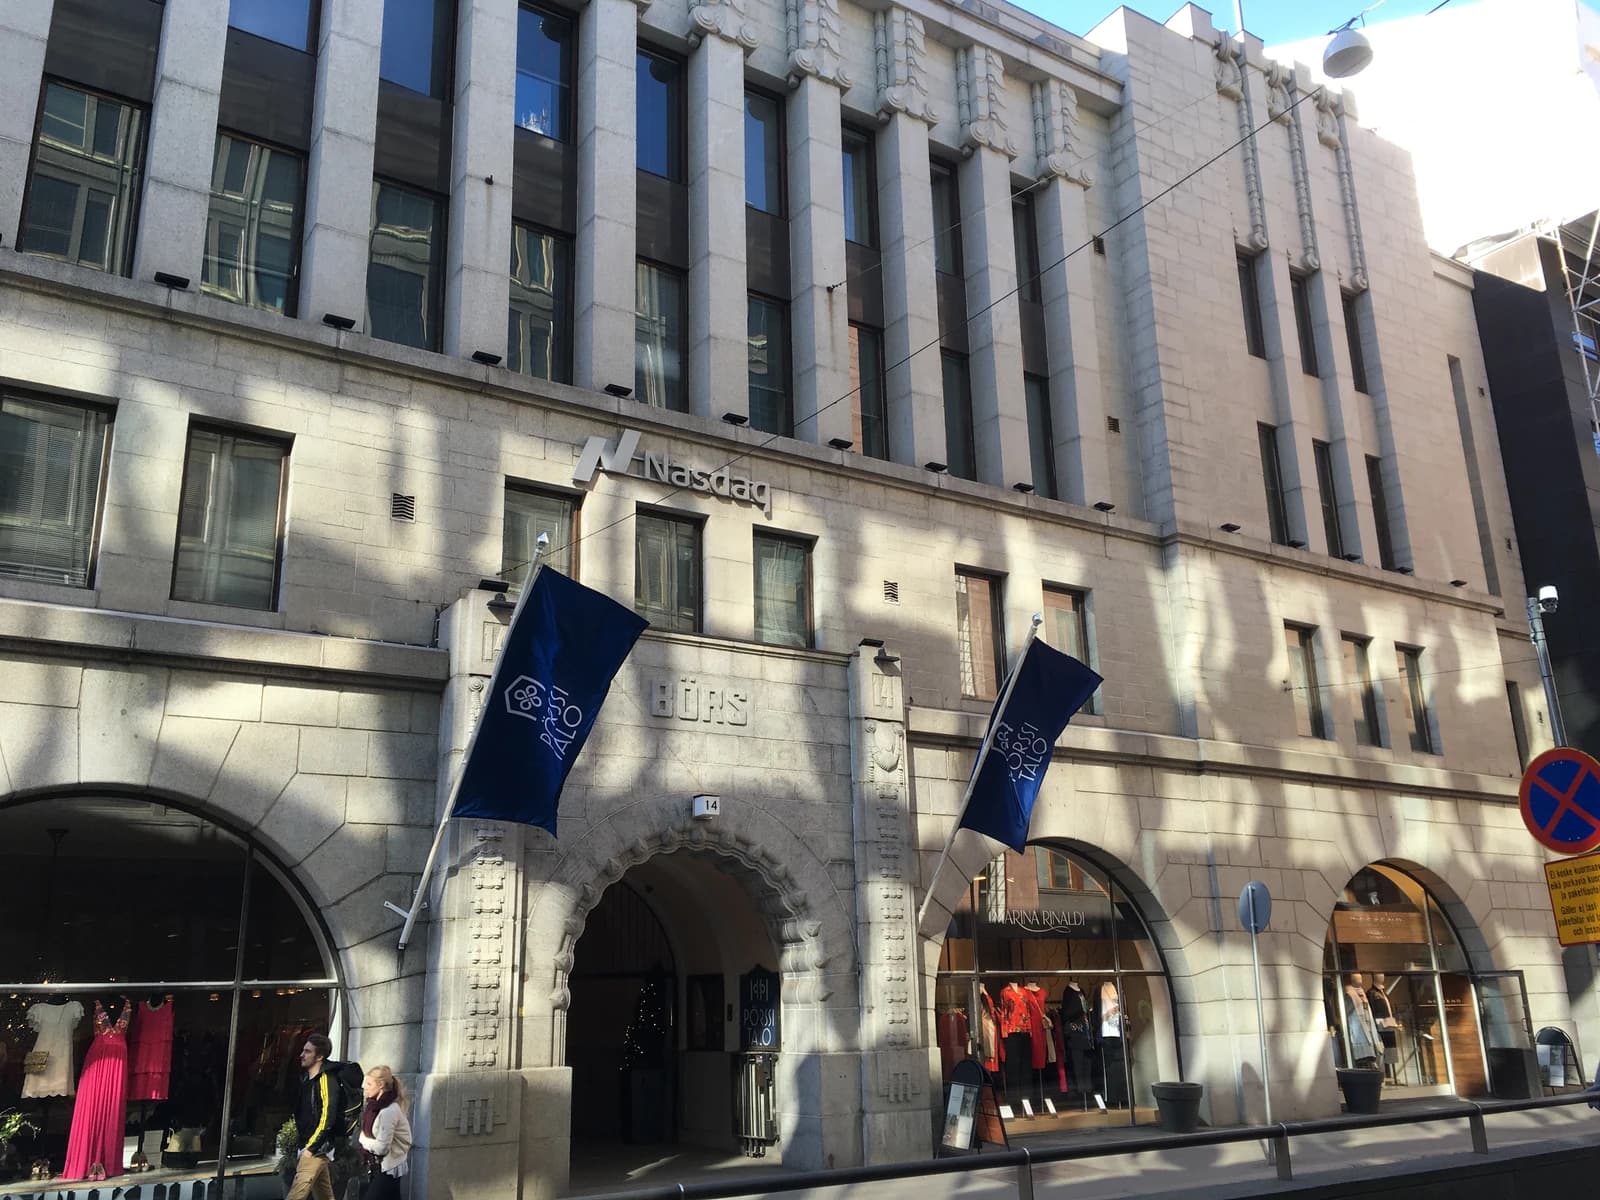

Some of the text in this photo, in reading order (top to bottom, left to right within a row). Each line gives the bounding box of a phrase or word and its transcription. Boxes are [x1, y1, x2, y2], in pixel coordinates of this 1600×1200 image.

[644, 451, 770, 515] Nasdaq
[649, 677, 748, 727] BÖRS
[1018, 737, 1047, 781] TALO
[706, 799, 718, 811] 14
[1042, 910, 1086, 926] RINALDI
